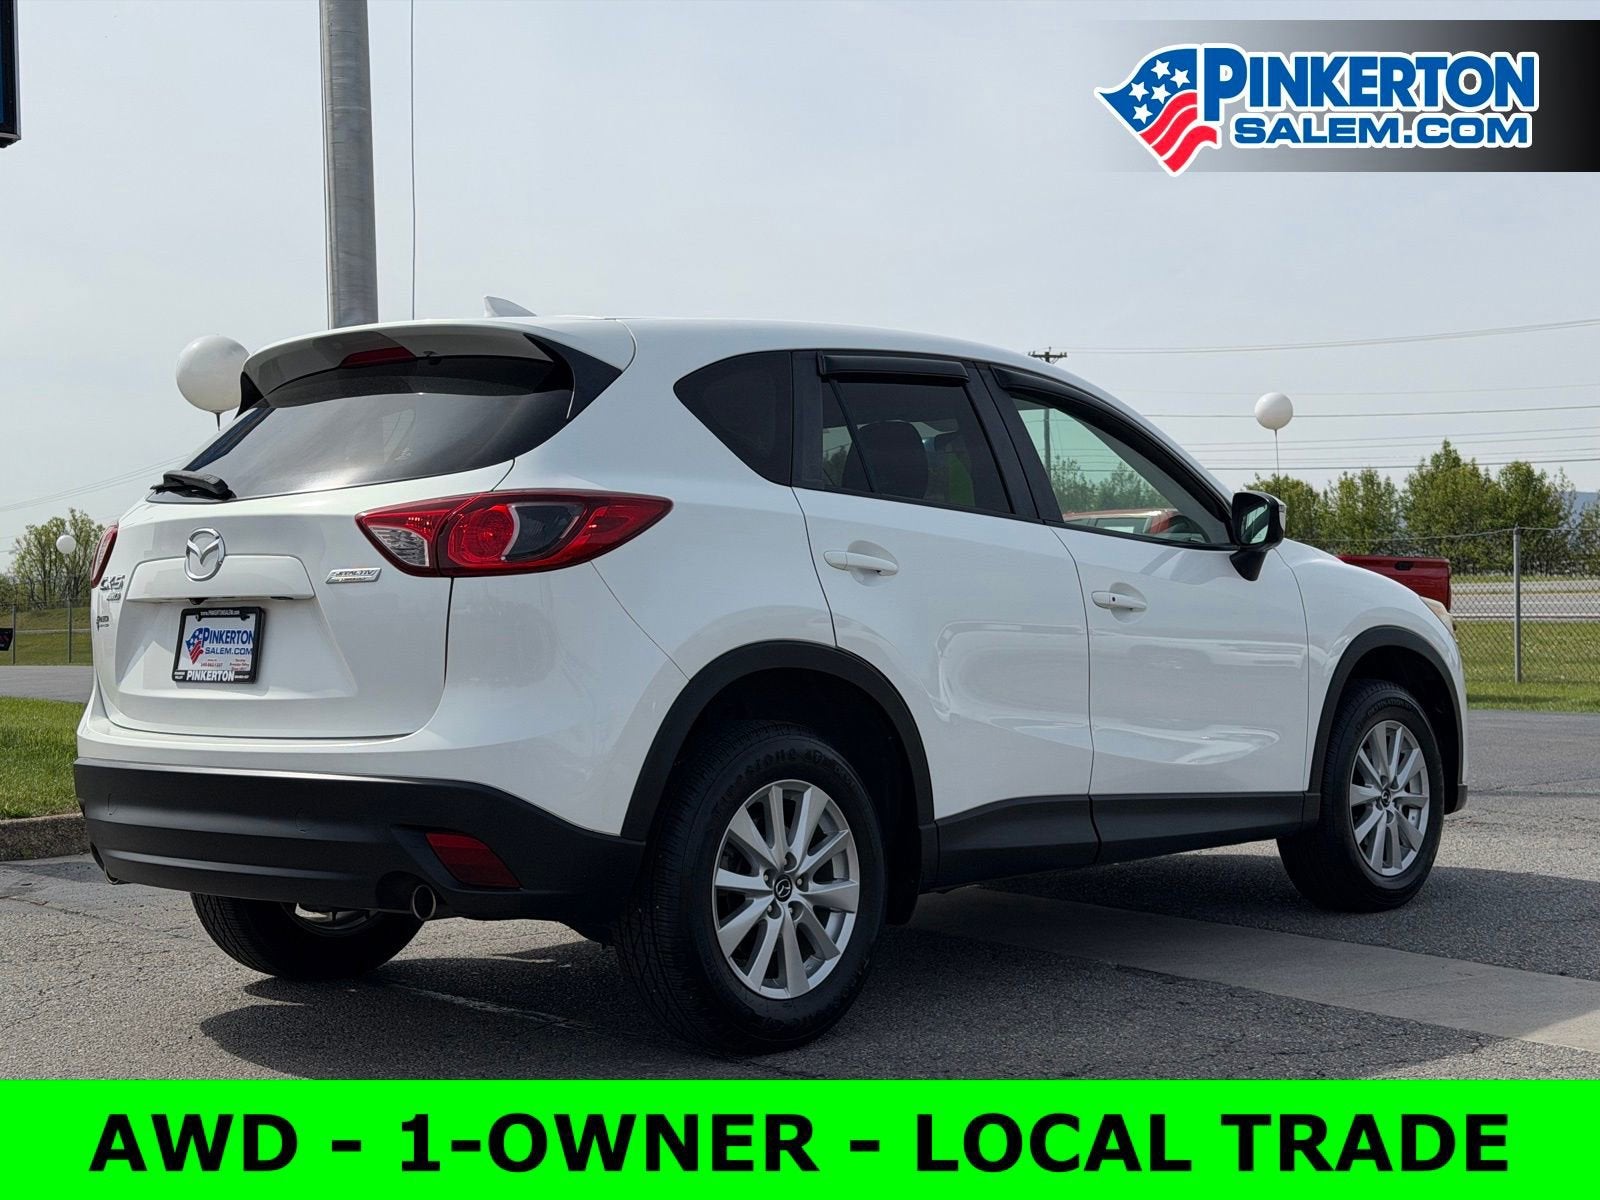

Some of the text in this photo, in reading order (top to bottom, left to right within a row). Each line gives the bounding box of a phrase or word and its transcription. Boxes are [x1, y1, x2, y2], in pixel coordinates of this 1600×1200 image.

[202, 627, 255, 648] PINKERTON
[205, 646, 253, 656] SALEM.COM
[186, 670, 235, 682] PINKERTON
